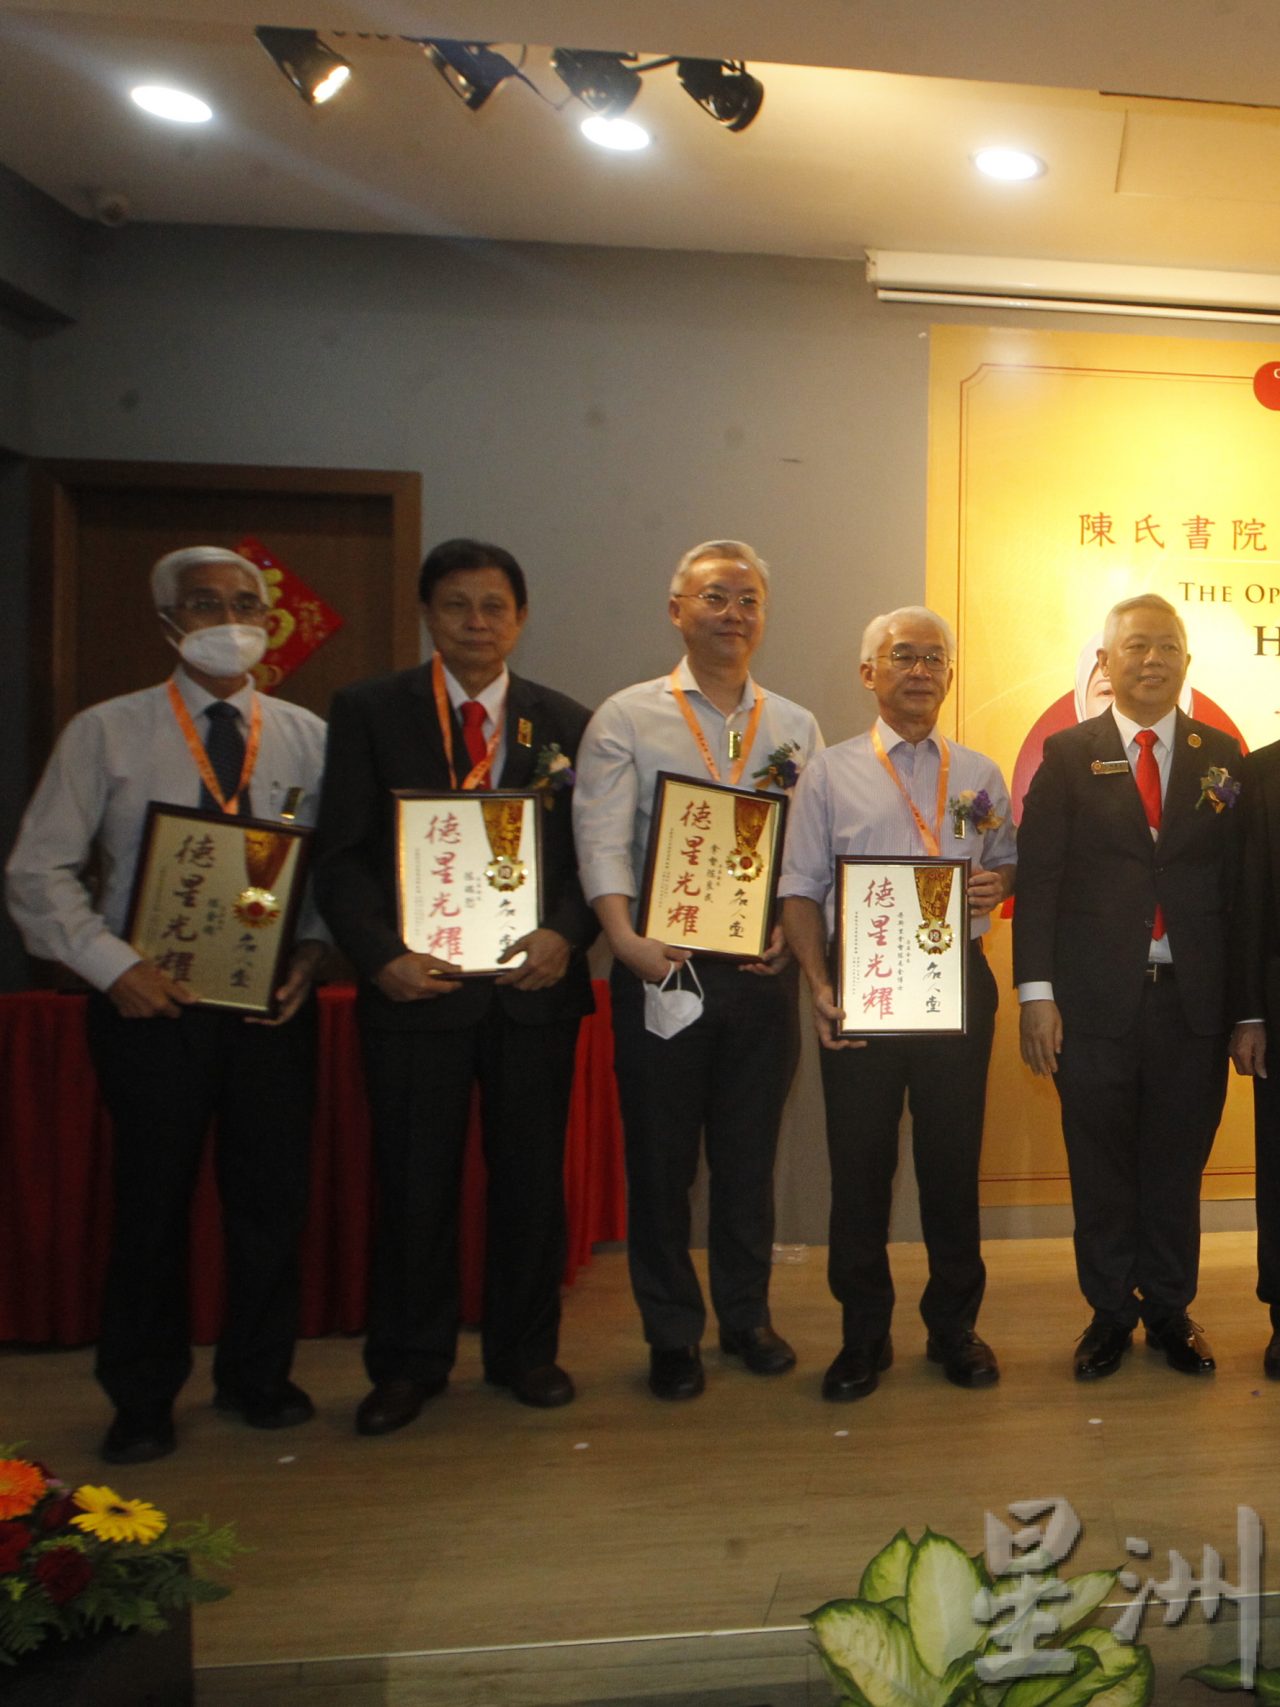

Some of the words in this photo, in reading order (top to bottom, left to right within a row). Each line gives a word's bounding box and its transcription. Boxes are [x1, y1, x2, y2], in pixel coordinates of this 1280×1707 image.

[1079, 511, 1268, 551] 陳氏書院
[1178, 582, 1233, 603] THE
[667, 800, 712, 936] 德星光耀
[862, 876, 895, 1020] 德星光耀
